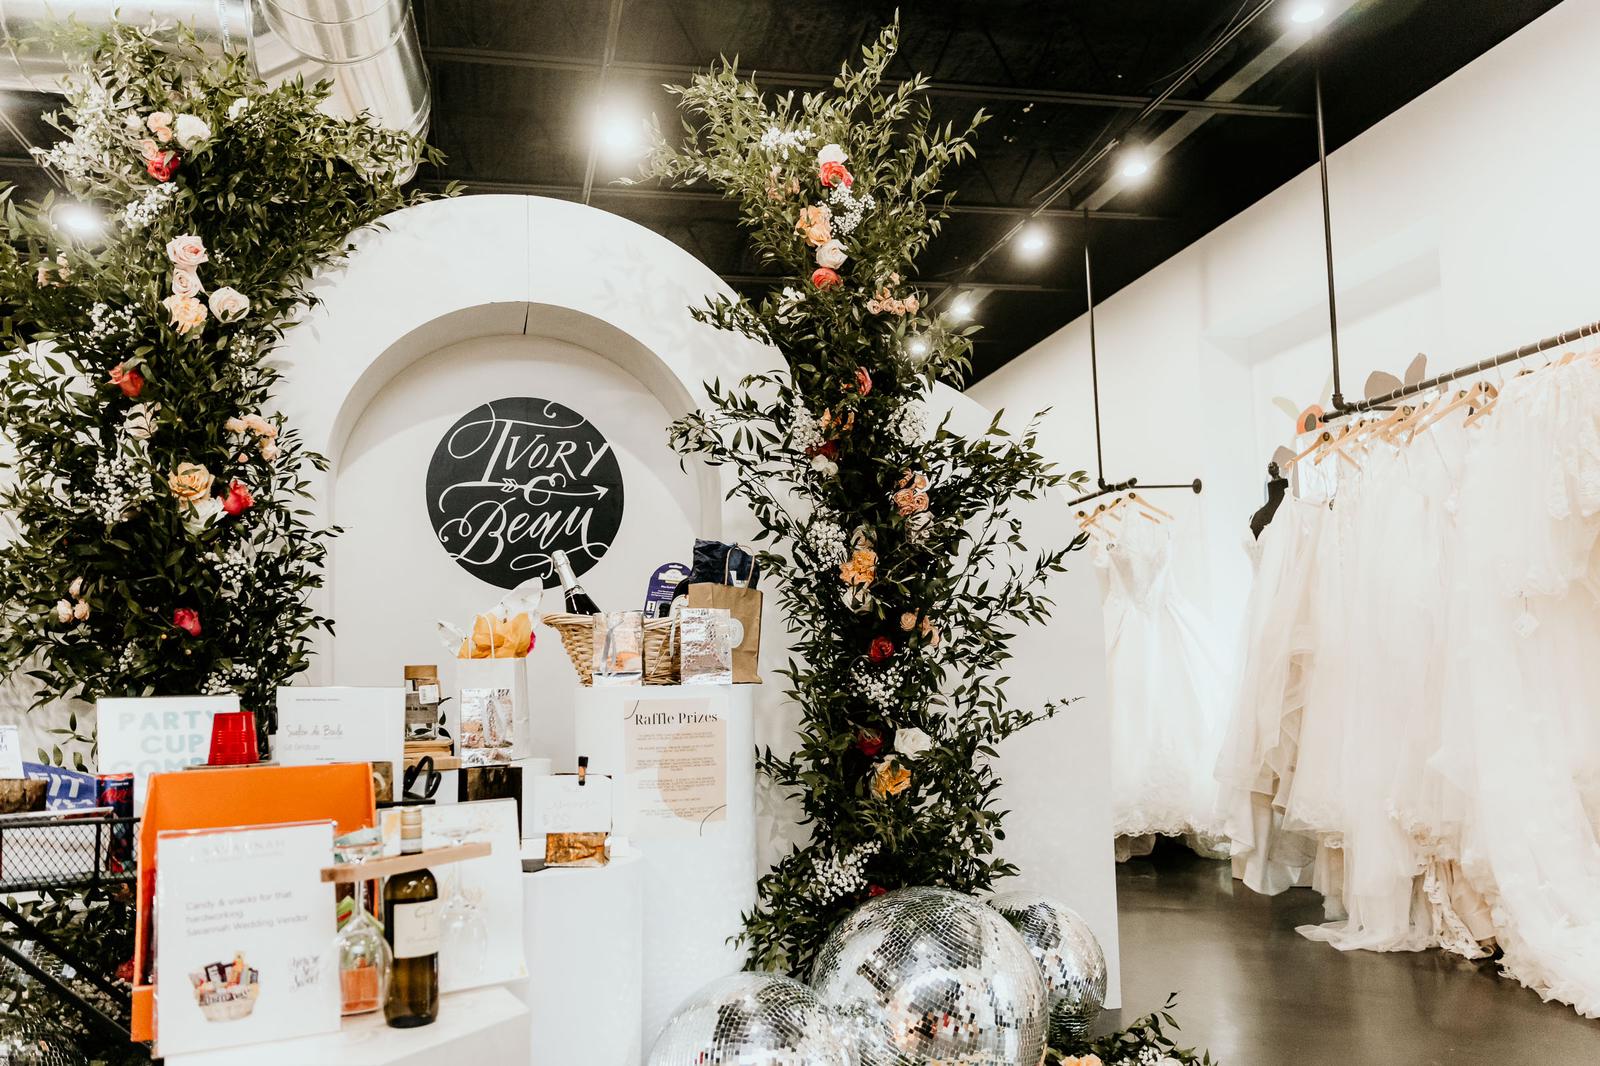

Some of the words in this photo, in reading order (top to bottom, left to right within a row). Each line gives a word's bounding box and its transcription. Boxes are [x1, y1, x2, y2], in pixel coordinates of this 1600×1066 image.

[442, 498, 608, 565] Beau
[635, 712, 674, 725] Raffle
[679, 711, 718, 724] Prizes
[141, 734, 204, 753] CUP
[185, 899, 215, 912] Candy
[228, 895, 257, 906] snacks
[259, 892, 272, 902] for
[275, 890, 292, 900] that
[185, 910, 244, 924] hardworking
[186, 923, 230, 937] Savannah
